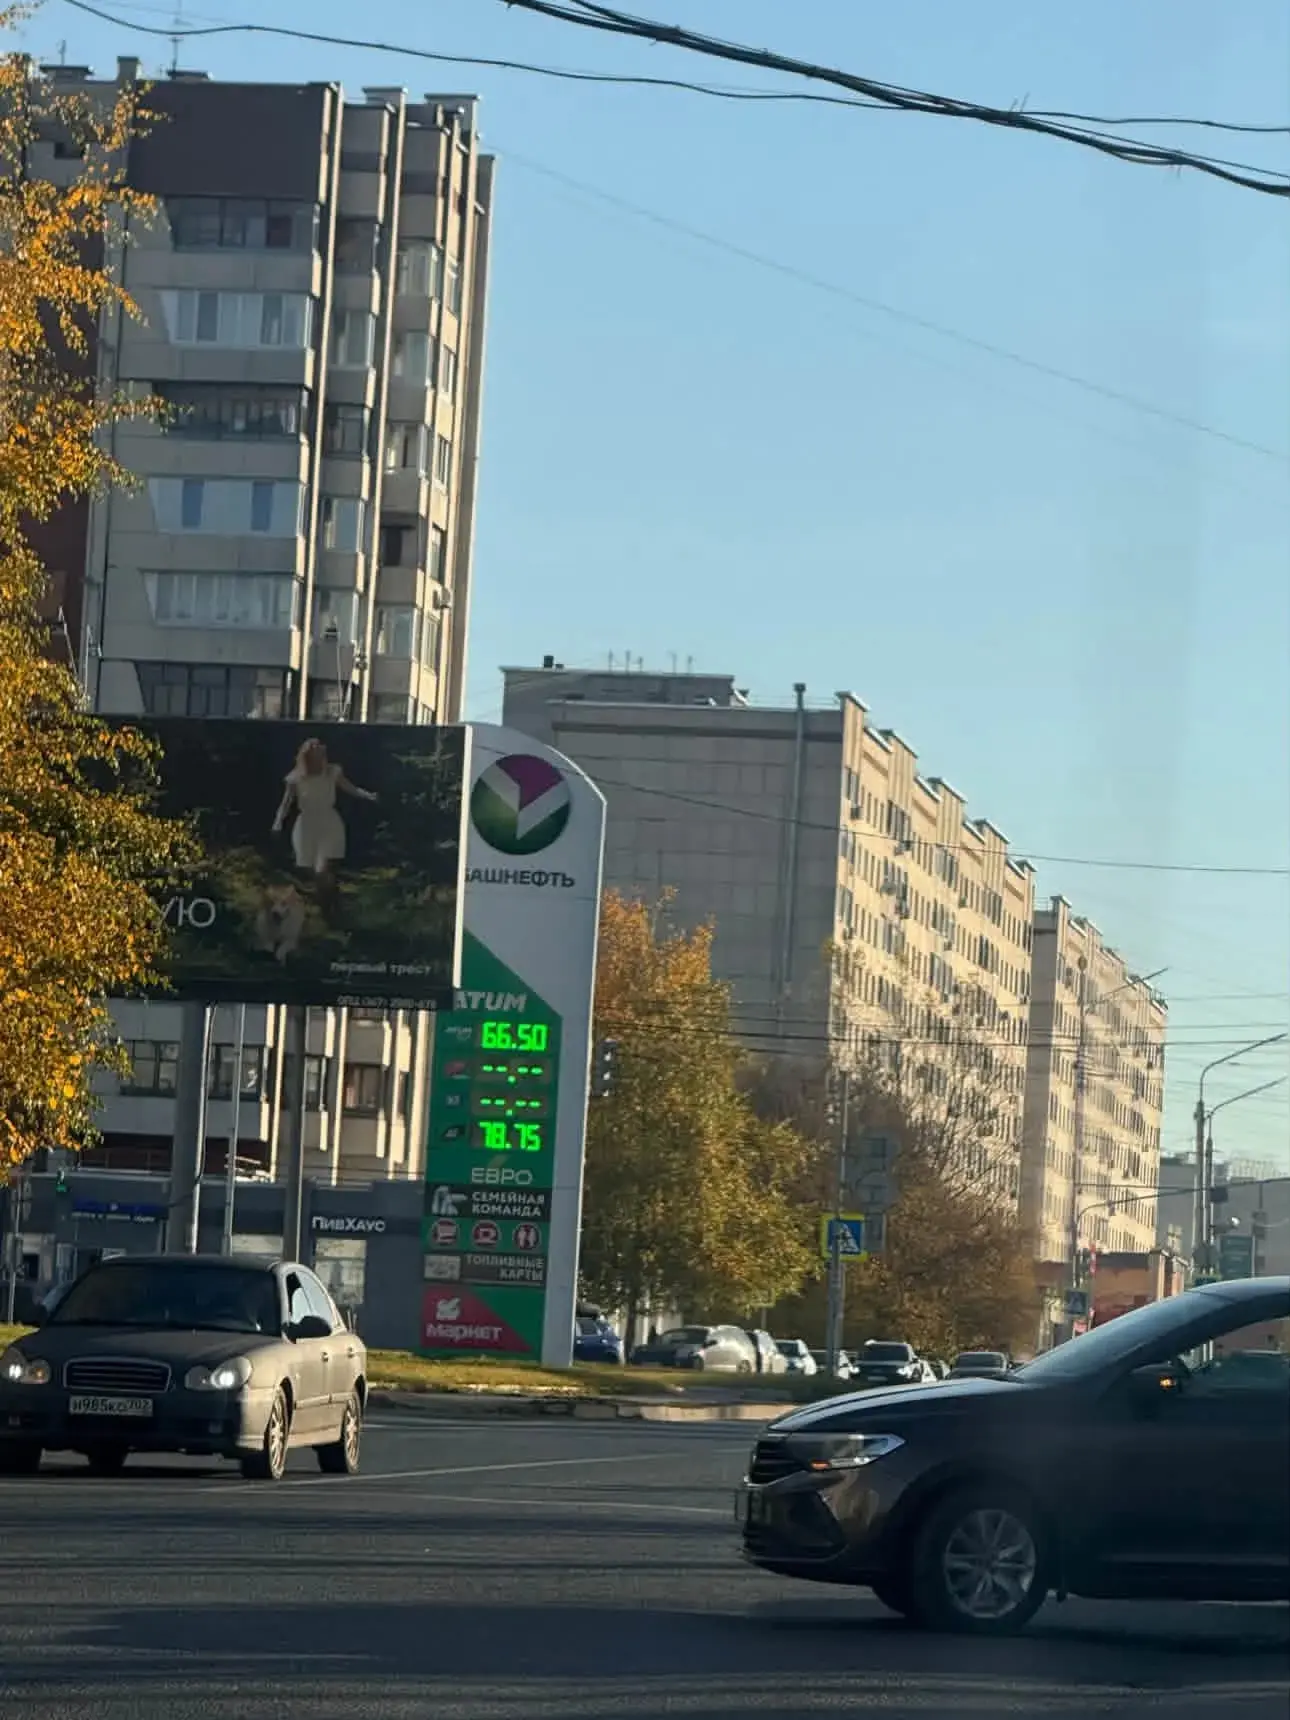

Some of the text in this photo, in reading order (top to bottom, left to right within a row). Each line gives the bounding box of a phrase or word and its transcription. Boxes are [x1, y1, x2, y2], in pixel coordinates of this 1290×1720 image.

[481, 1021, 548, 1051] 66.50
[479, 1121, 541, 1151] 78.75
[471, 1167, 533, 1185] ЕВРО
[471, 1190, 545, 1205] СЕМЕЙНАЯ
[471, 1203, 542, 1217] КОМАНДА
[466, 1253, 545, 1269] ТОПЛИВНЫЕ
[499, 1267, 544, 1281] КАРТЫ
